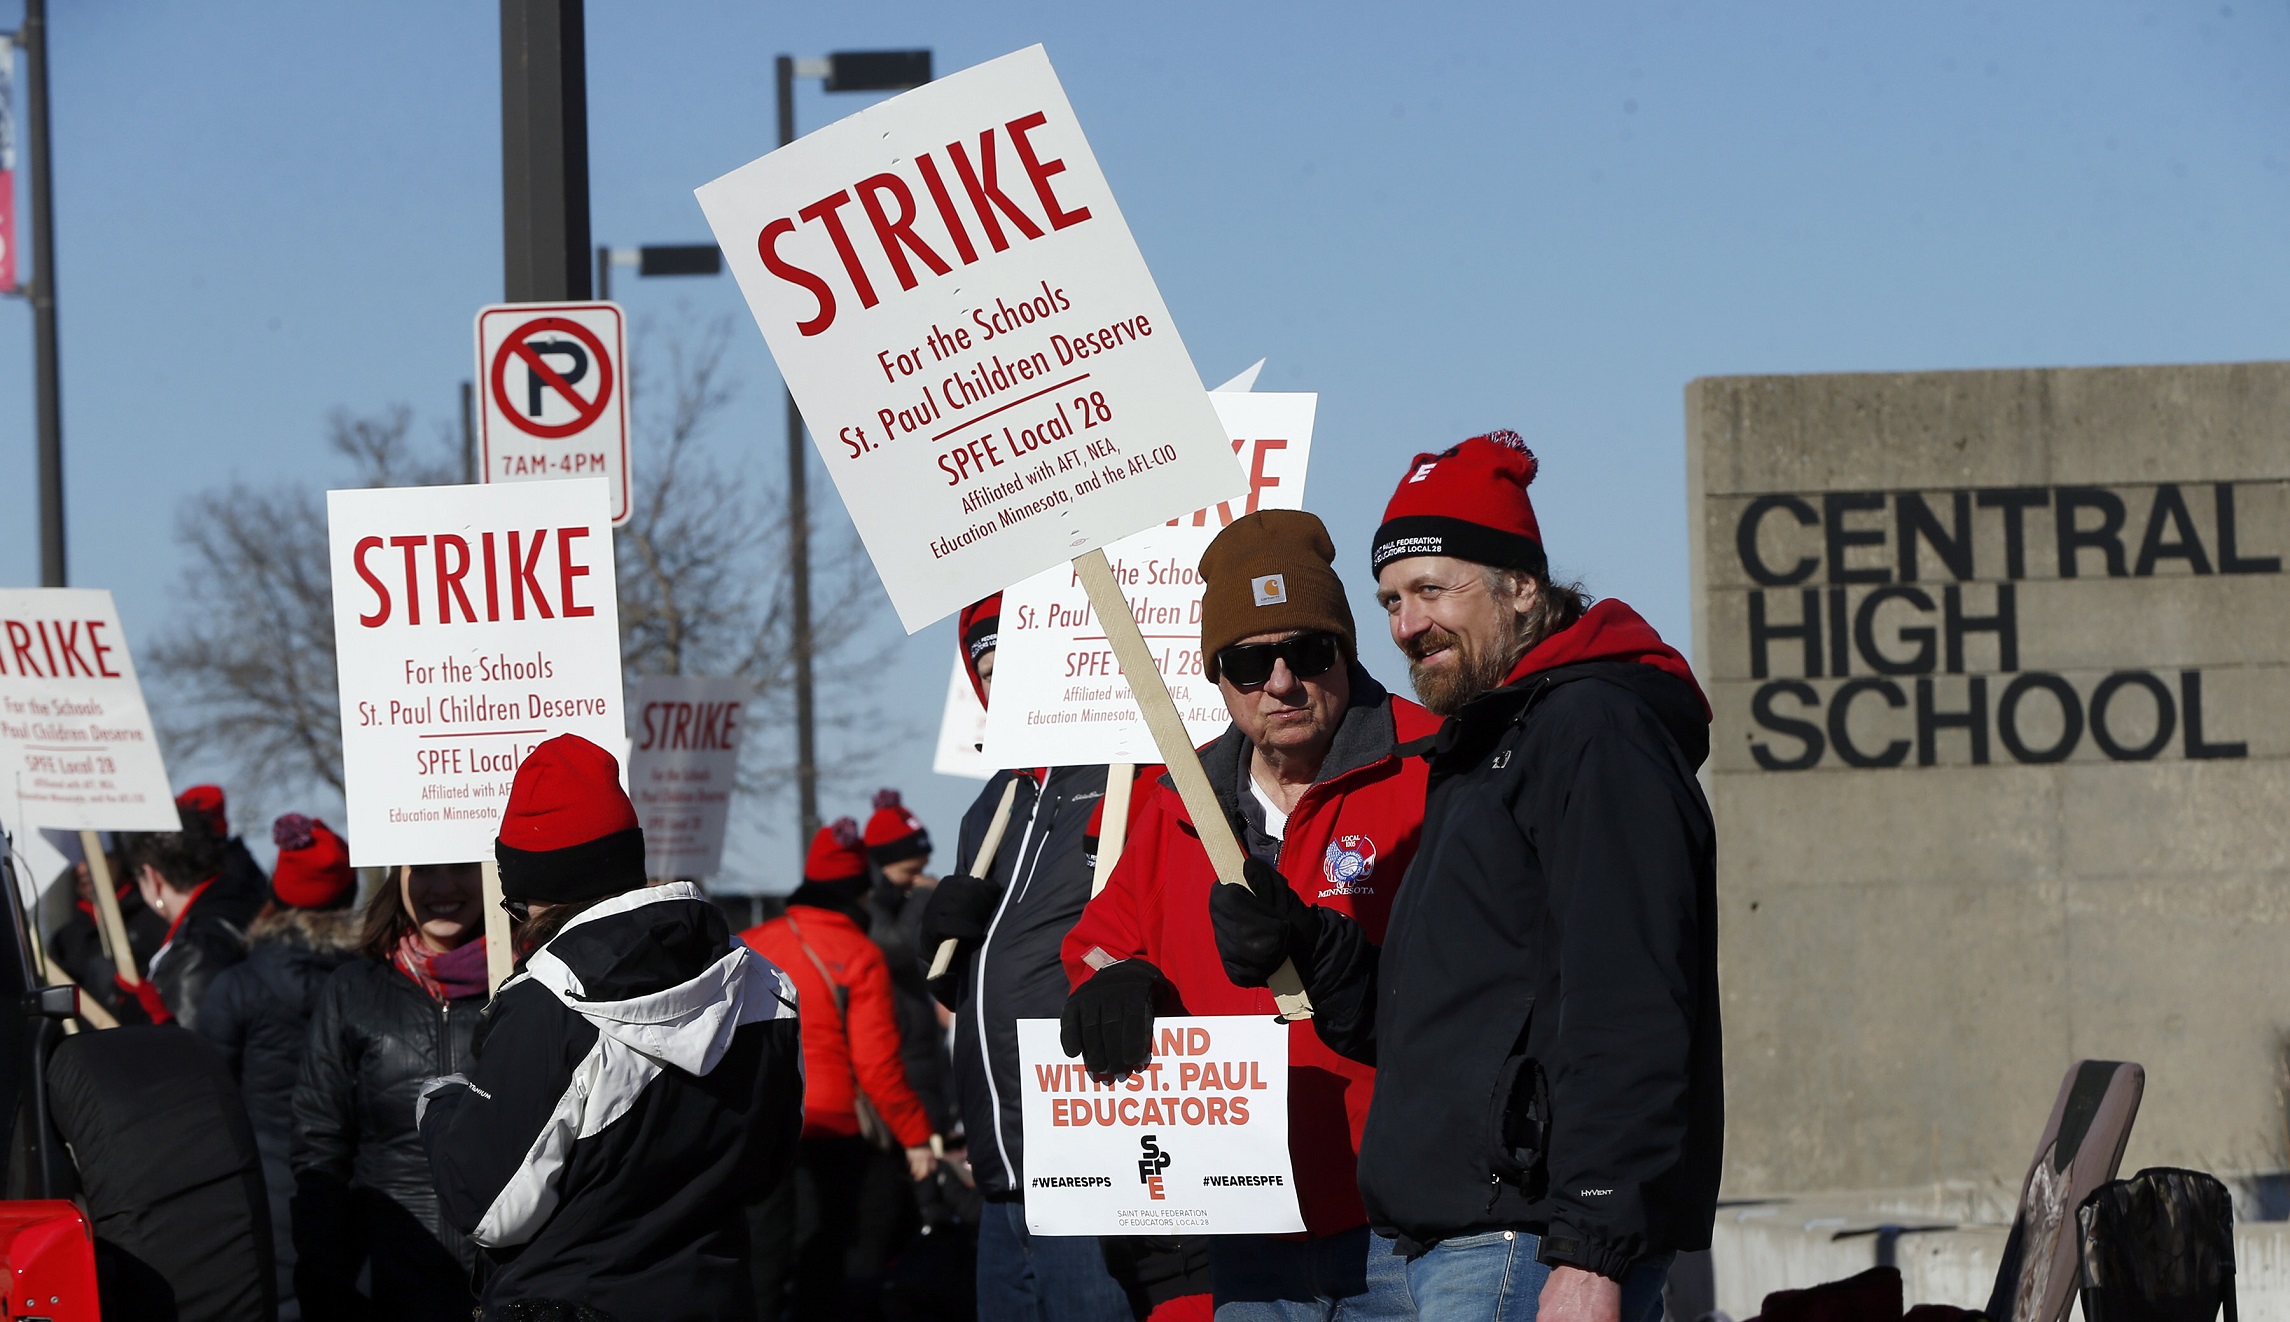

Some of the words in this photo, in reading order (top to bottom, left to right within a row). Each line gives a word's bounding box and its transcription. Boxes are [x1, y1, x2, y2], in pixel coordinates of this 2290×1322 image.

[758, 110, 1093, 337] STRIKE
[877, 347, 923, 383] For
[927, 324, 972, 361] the
[972, 280, 1071, 341] Schools
[839, 426, 879, 459] St.
[877, 386, 941, 440] Paul
[942, 355, 1051, 410] Children
[1050, 314, 1152, 366] Deserve
[937, 433, 1005, 486] SPFE
[1003, 402, 1074, 457] Local
[1073, 391, 1112, 429] 28
[502, 453, 606, 475] 7AM-4PM
[961, 472, 1025, 515] Affiliated
[1025, 460, 1056, 486] with
[1057, 449, 1088, 473] AFT,
[1086, 437, 1121, 460] NEA,
[929, 519, 998, 559] Education
[997, 489, 1074, 528] Minnesota,
[1074, 470, 1102, 496] and
[1102, 464, 1126, 485] the
[1127, 444, 1178, 476] AFL-CIO
[1396, 537, 1442, 546] FEDERATION
[1736, 482, 2281, 587] CENTRAL
[353, 526, 595, 629] STRIKE
[1147, 558, 1206, 585] Schoo
[1017, 605, 1039, 630] St.
[1047, 599, 1091, 628] Paul
[1128, 597, 1181, 625] ldren
[1747, 583, 2019, 679] HIGH
[405, 659, 435, 685] For
[442, 655, 472, 683] the
[479, 651, 553, 682] Schools
[1065, 651, 1112, 678] SPFE
[1176, 651, 1202, 675] 28
[51, 697, 104, 716] Schools
[1063, 685, 1112, 702] Affiliated
[1168, 686, 1192, 702] NEA,
[359, 701, 383, 727] St.
[390, 696, 432, 725] Paul
[440, 694, 520, 723] Children
[528, 693, 606, 719] Deserve
[1027, 710, 1077, 725] Education
[1080, 709, 1138, 723] Minnesota,
[1188, 708, 1230, 722] AFL-CIO
[1750, 669, 2248, 771] SCHOOL
[90, 724, 144, 742] Deserve
[640, 701, 741, 751] STRIKE
[417, 748, 462, 775] SPFE
[470, 744, 518, 773] Local
[421, 783, 469, 801] Affiliated
[473, 782, 495, 798] with
[389, 807, 440, 823] Education
[443, 806, 501, 822] Minnesota,
[1317, 887, 1374, 898] MINNESOTA
[1125, 1062, 1170, 1092] ST.
[1180, 1061, 1267, 1091] PAUL
[1052, 1096, 1250, 1127] EDUCATORS
[1031, 1176, 1112, 1188] #WEARESPPS
[1203, 1175, 1284, 1187] #WEARESPFE
[1160, 1209, 1207, 1217] FEDERATION
